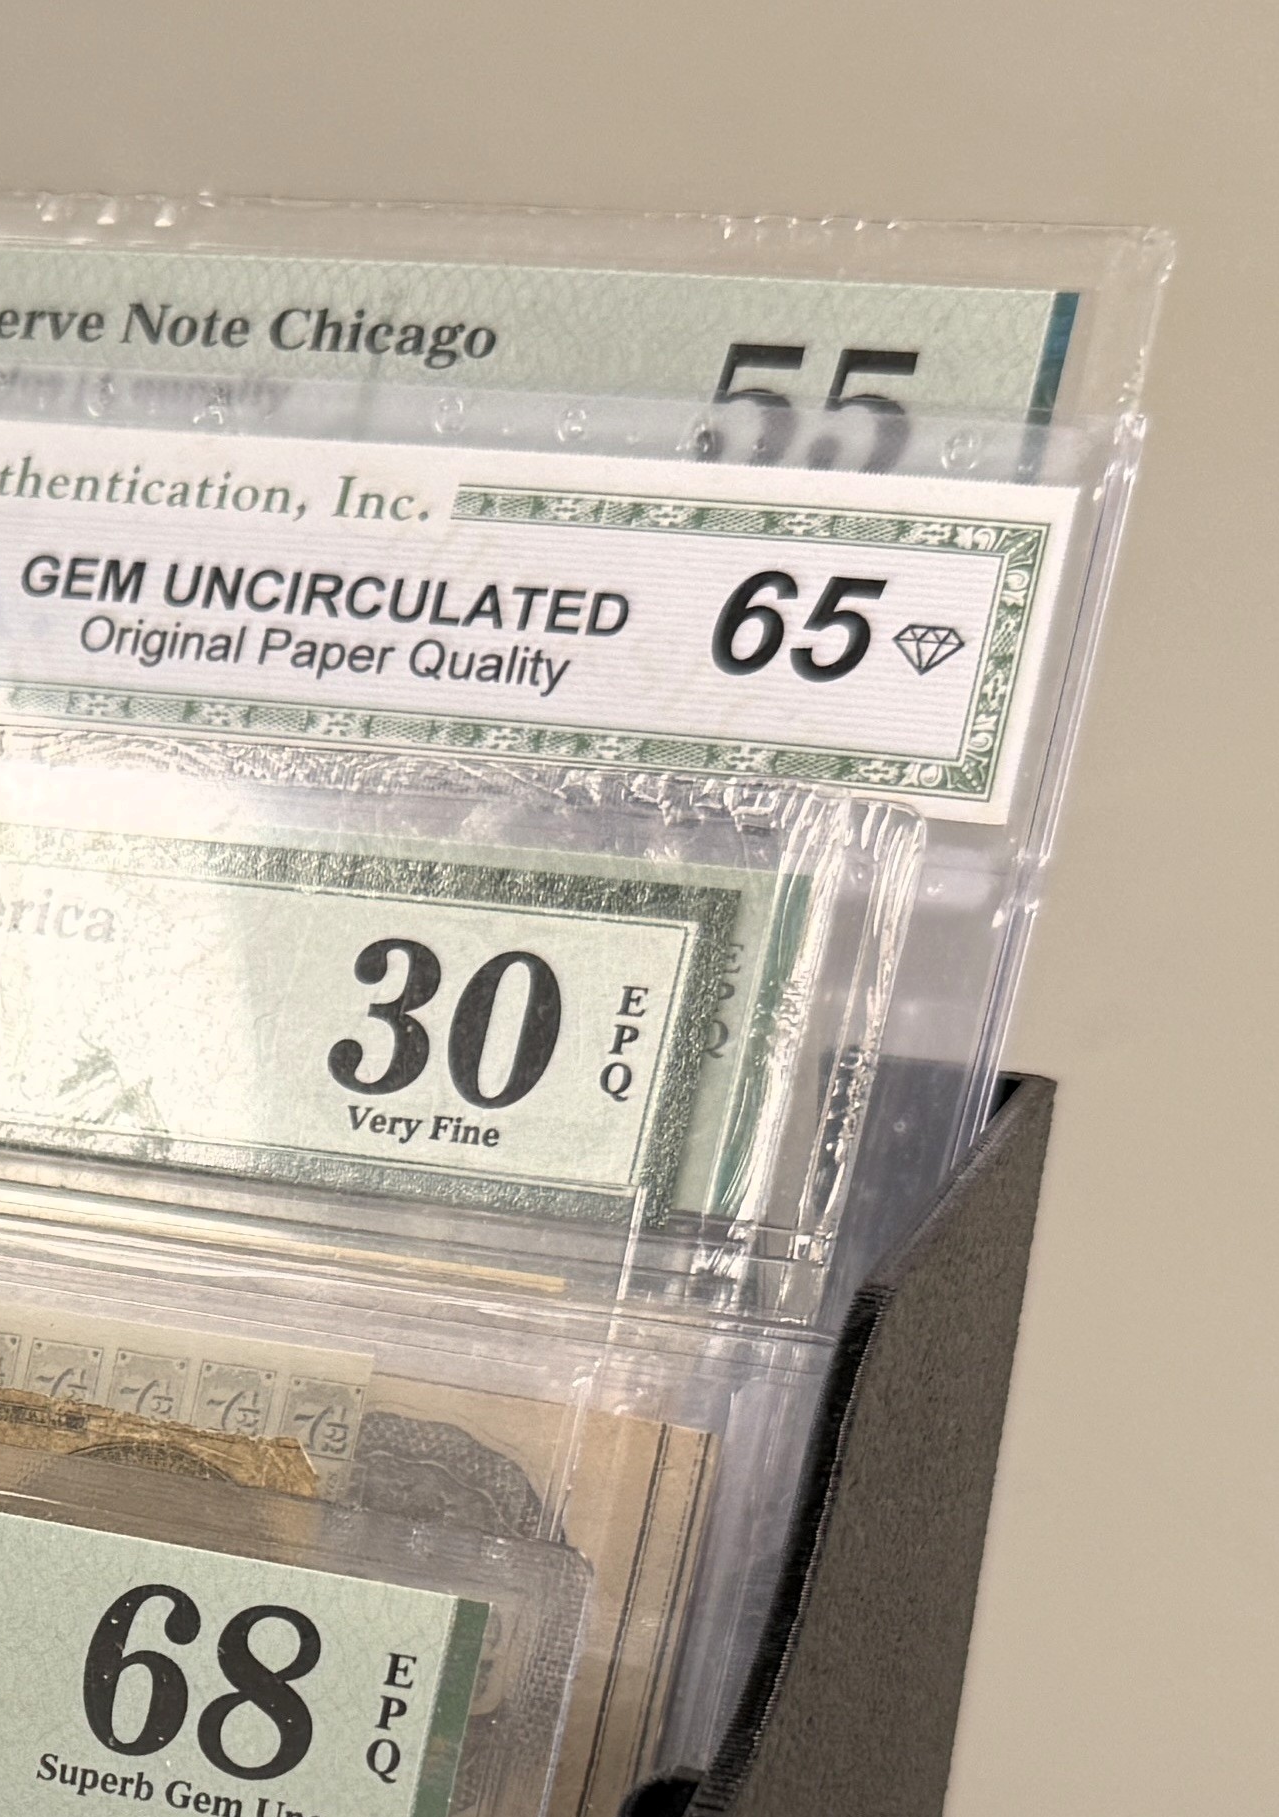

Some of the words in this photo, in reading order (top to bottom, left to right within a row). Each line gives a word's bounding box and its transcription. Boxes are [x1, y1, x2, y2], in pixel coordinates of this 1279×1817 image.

[120, 302, 250, 349] Note
[268, 308, 498, 370] Chicago
[690, 343, 919, 473] 55
[331, 474, 432, 523] Inc.
[19, 554, 147, 602] GEM
[160, 563, 631, 638] UNCIRCULATED
[709, 569, 888, 683] 65
[79, 615, 246, 668] Original
[258, 627, 394, 681] Paper
[408, 638, 572, 697] Quality
[327, 937, 562, 1110] 30
[346, 1104, 425, 1146] Very
[430, 1114, 500, 1149] Fine
[81, 1583, 322, 1781] 68
[36, 1751, 156, 1803] Superb
